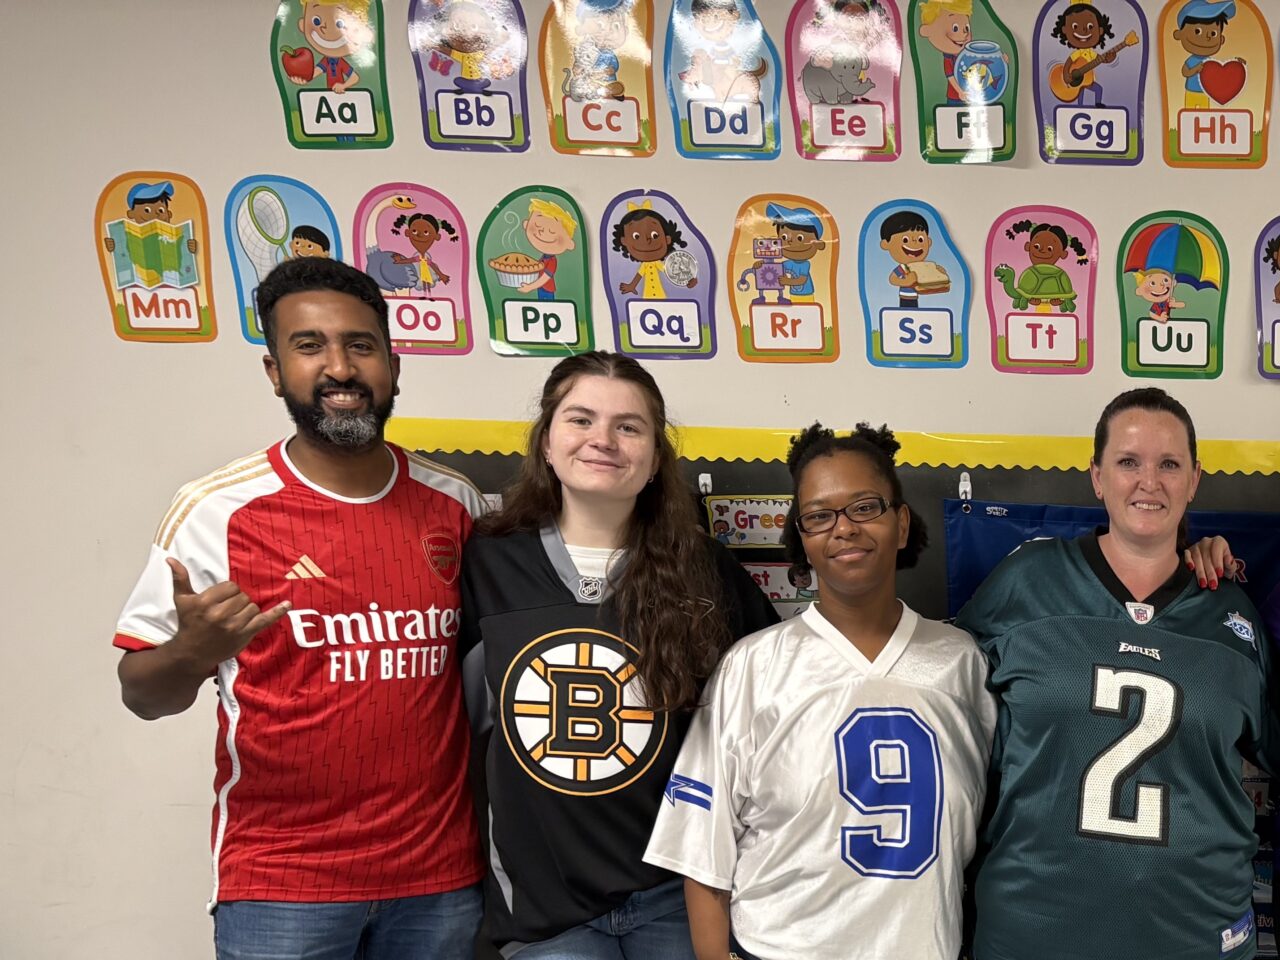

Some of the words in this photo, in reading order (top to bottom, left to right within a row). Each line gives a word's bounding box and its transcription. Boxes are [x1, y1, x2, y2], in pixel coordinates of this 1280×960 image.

[314, 95, 358, 125] Aa
[453, 97, 496, 127] Bb
[581, 102, 622, 133] Cc
[704, 106, 749, 135] Dd
[830, 107, 867, 137] Ee
[956, 109, 986, 139] Ff
[1069, 112, 1114, 148] Gg
[1193, 114, 1237, 145] Hh
[131, 292, 192, 319] Mm
[396, 303, 442, 332] Oo
[521, 305, 562, 340] Pp
[640, 308, 691, 342] Qq
[770, 311, 802, 339] Rr
[898, 317, 933, 345] Ss
[1025, 322, 1058, 350] Tt
[1151, 325, 1193, 353] Uu
[287, 602, 462, 648] Emirates
[330, 650, 370, 682] FLY
[380, 645, 448, 680] BETTER
[1119, 641, 1161, 661] EAGLES
[546, 666, 621, 758] B
[1077, 663, 1182, 845] 2
[834, 707, 944, 880] 9
